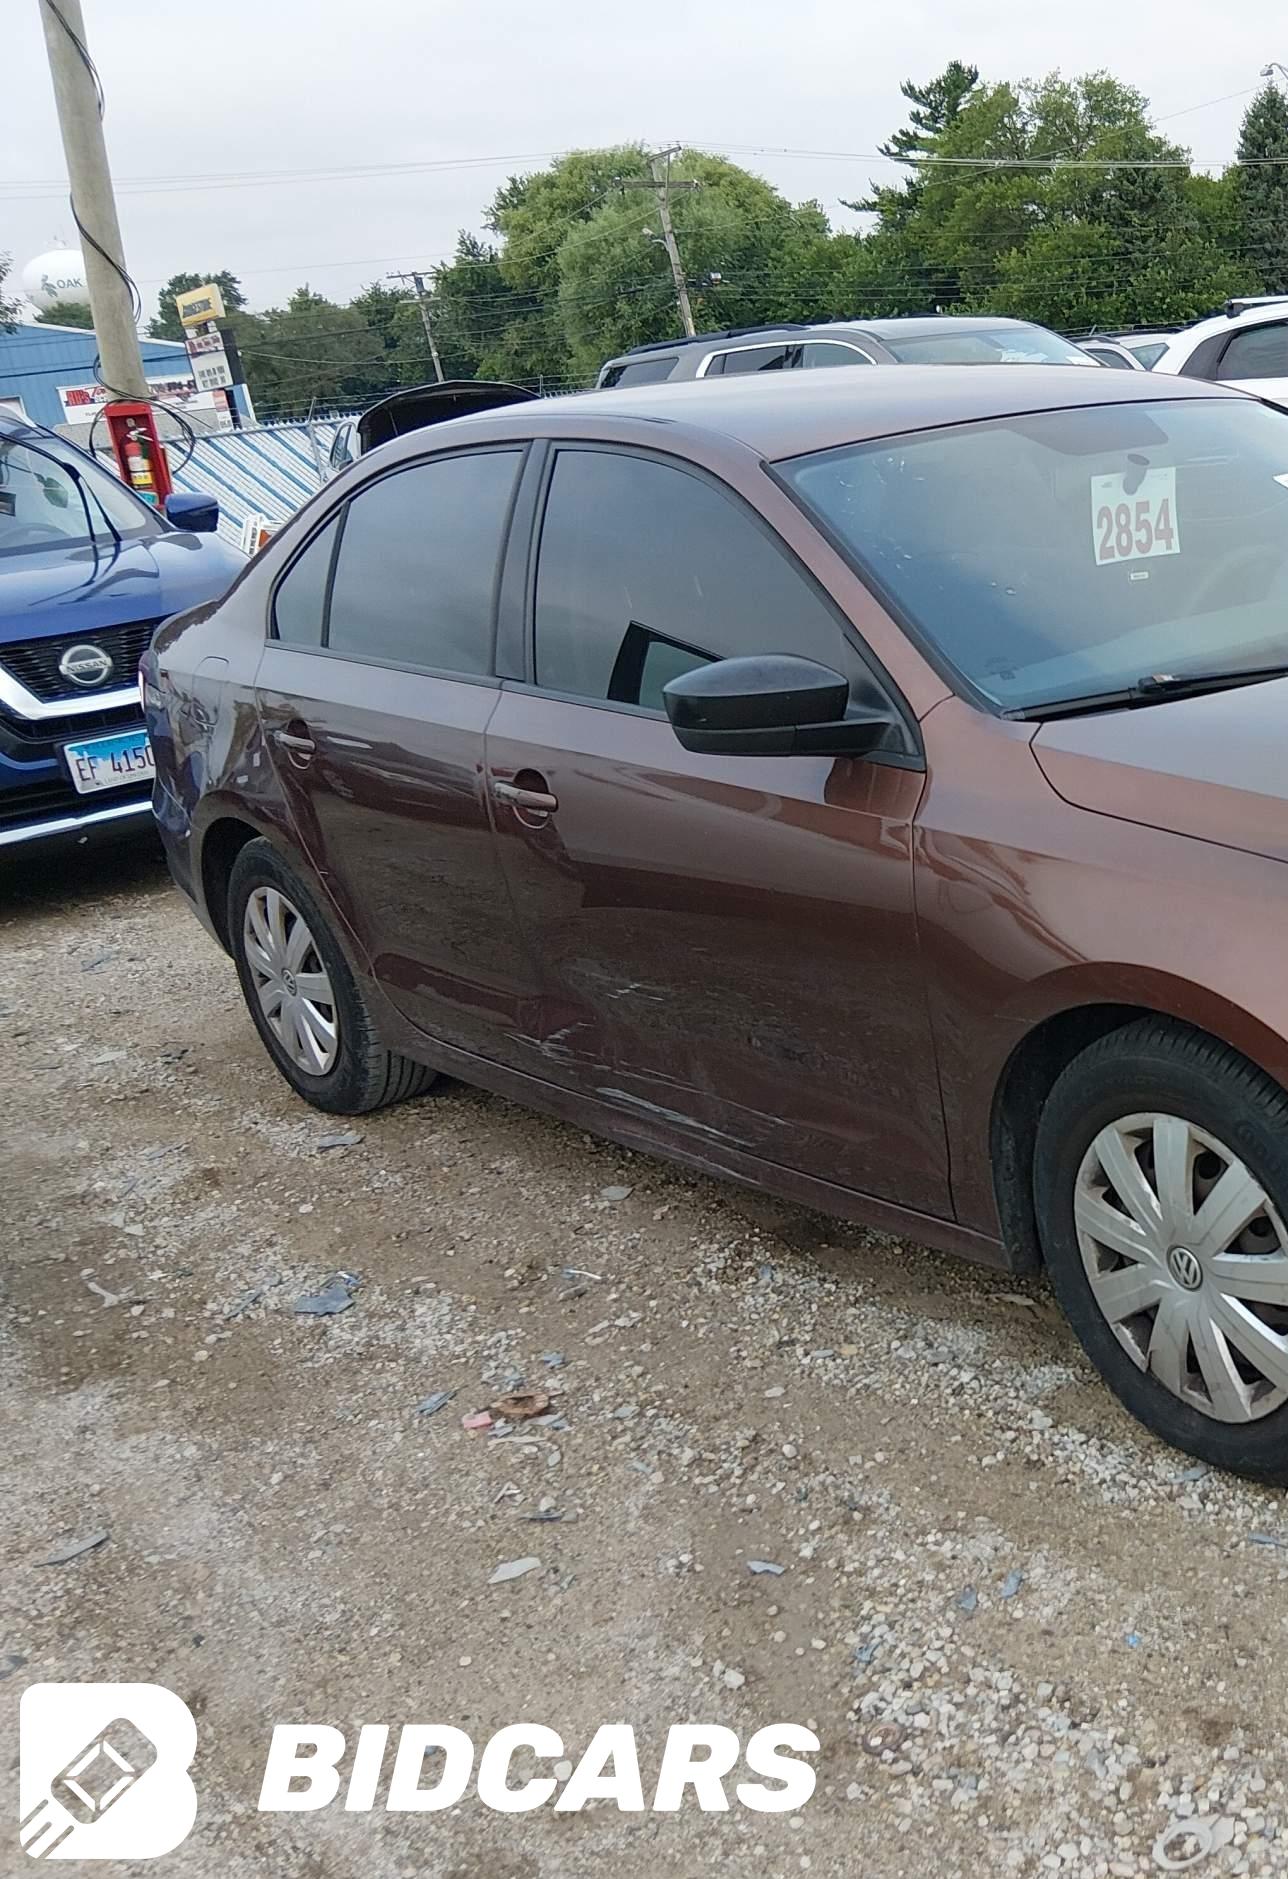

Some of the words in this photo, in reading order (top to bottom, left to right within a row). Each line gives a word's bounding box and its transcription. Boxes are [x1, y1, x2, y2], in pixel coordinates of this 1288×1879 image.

[56, 278, 83, 289] OAK
[1096, 498, 1174, 561] 2854
[75, 755, 97, 781] EF
